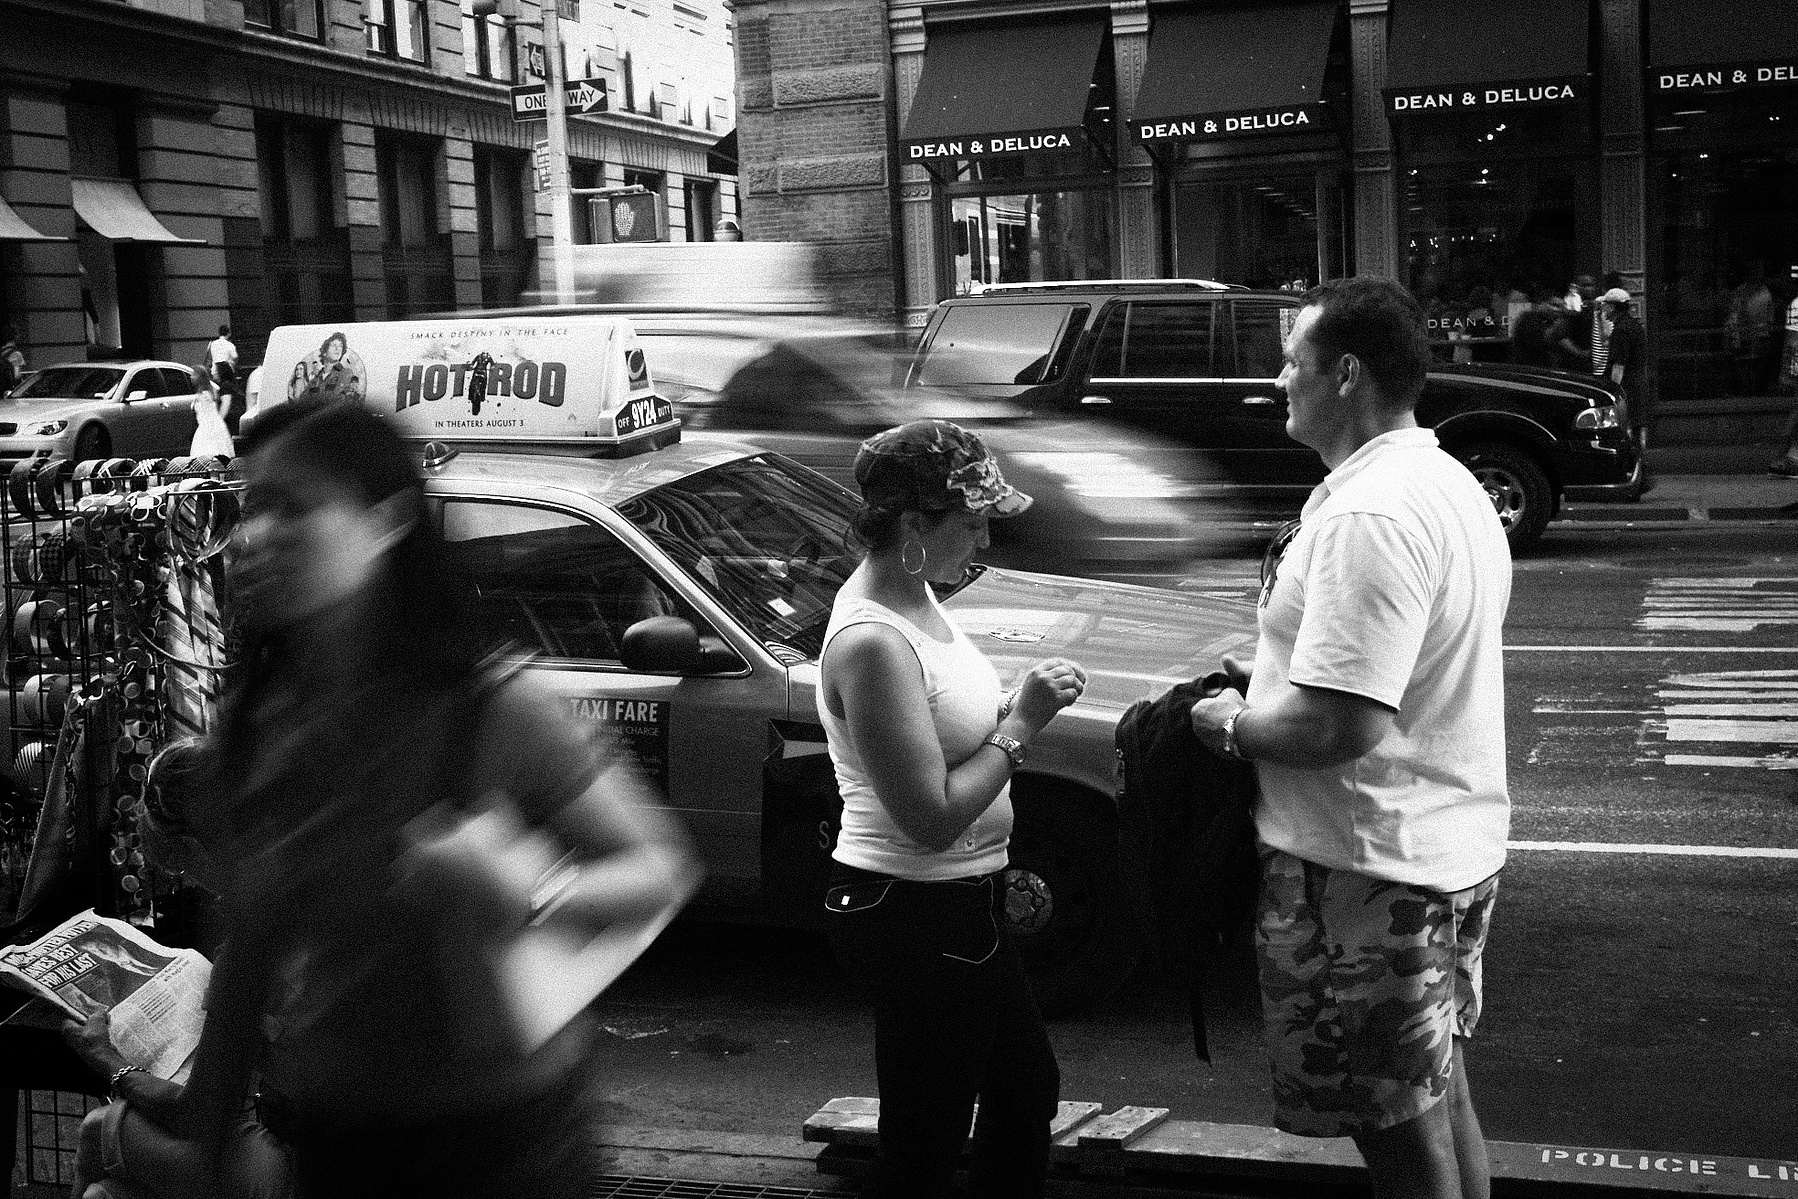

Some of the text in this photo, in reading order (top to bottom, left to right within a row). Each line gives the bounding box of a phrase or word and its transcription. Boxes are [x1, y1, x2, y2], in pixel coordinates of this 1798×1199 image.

[1660, 71, 1722, 89] DEAN
[1732, 69, 1747, 84] &
[568, 89, 595, 105] WAY
[1394, 85, 1575, 110] DEAN & DELUCA
[1140, 110, 1310, 139] DEAN & DELUCA
[910, 134, 1071, 158] DEAN & DELUCA
[410, 328, 568, 340] SMACK DESTINY IN THE FACE
[1427, 317, 1477, 329] DEAN
[1484, 315, 1495, 326] &
[396, 359, 567, 413] HOT ROD
[435, 419, 524, 428] IN THEATERS AUGUST 3
[617, 398, 671, 429] OFF 9Y24 DUTY
[570, 699, 659, 723] TAXI FARE
[37, 952, 97, 988] FOR HIS LAST
[1541, 1149, 1717, 1176] POLICE
